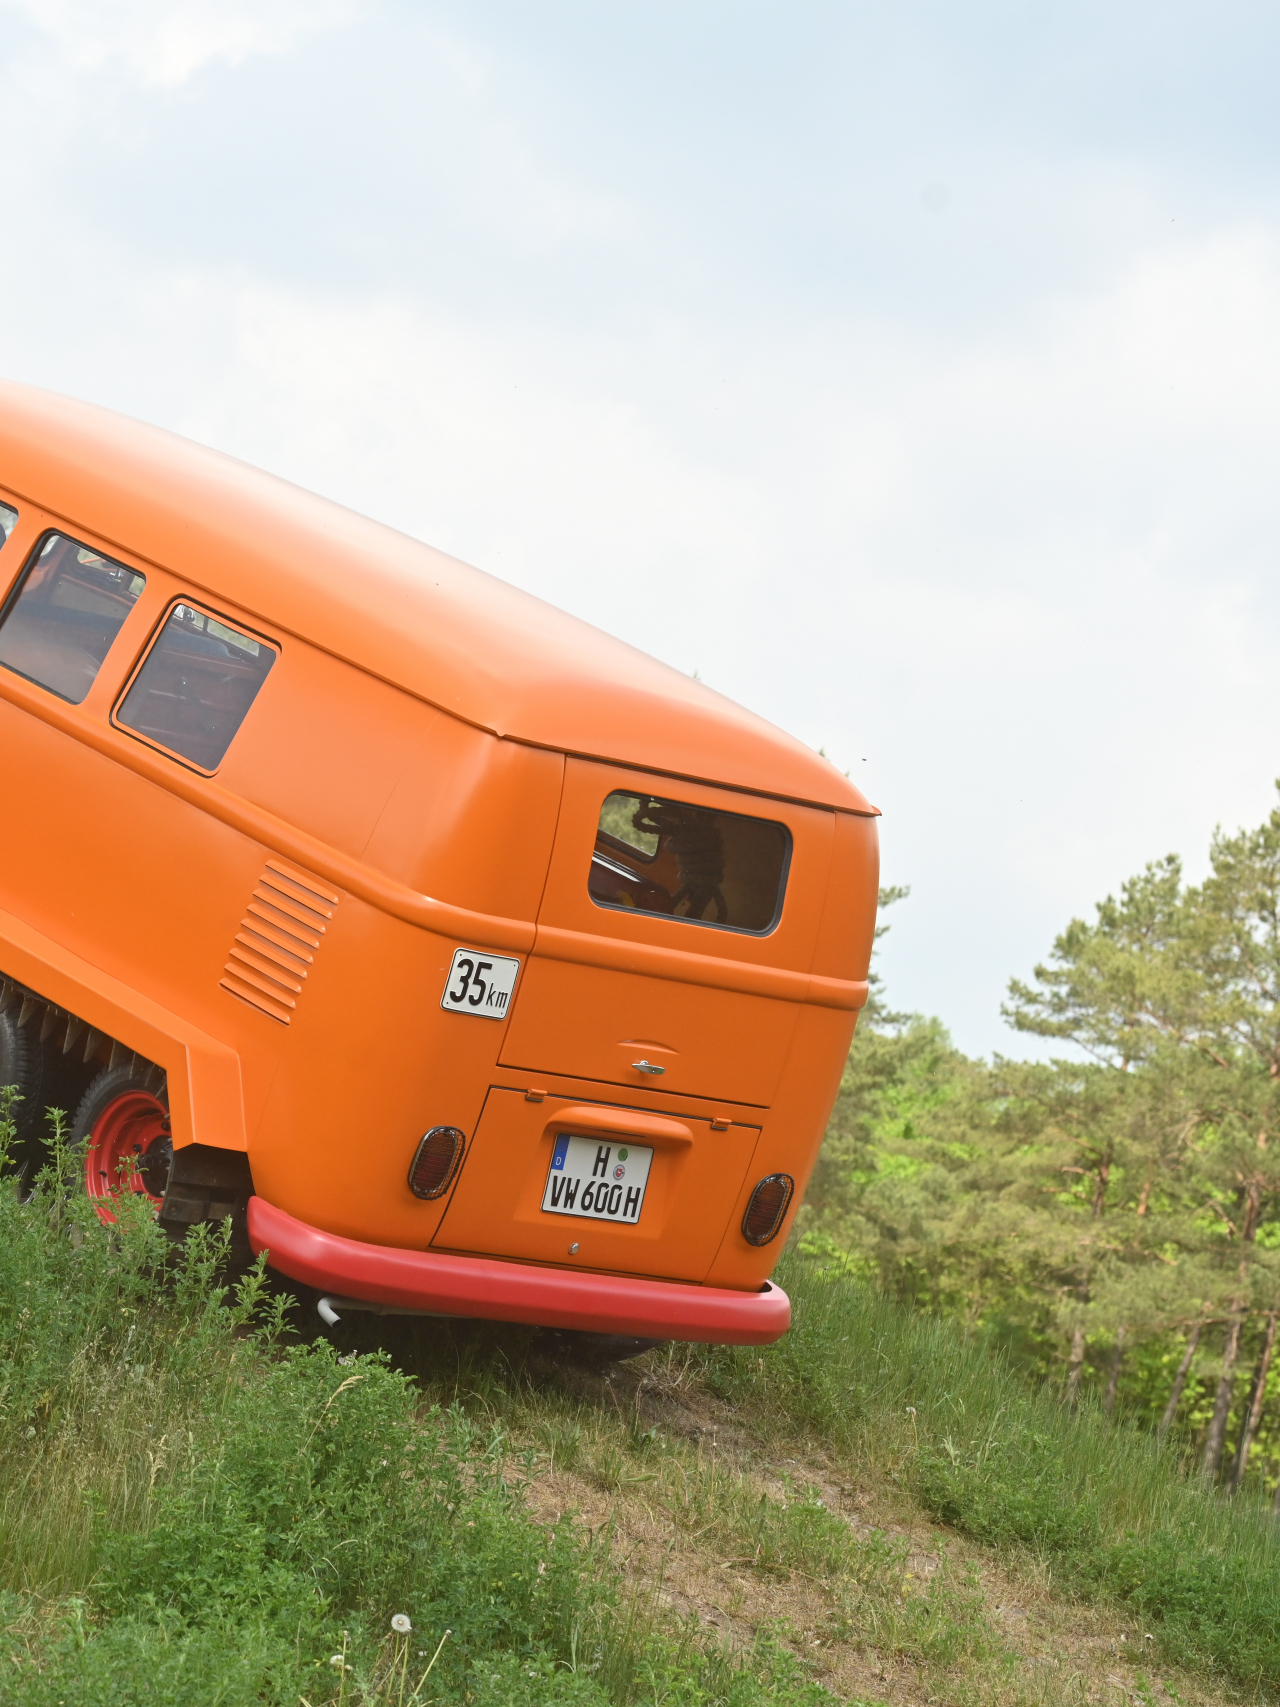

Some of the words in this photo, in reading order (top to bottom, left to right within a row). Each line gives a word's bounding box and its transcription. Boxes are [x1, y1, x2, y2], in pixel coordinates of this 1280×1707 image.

[449, 958, 493, 1006] 35
[485, 982, 508, 1008] km
[555, 1156, 562, 1166] D
[592, 1145, 611, 1177] H
[550, 1175, 580, 1209] VW
